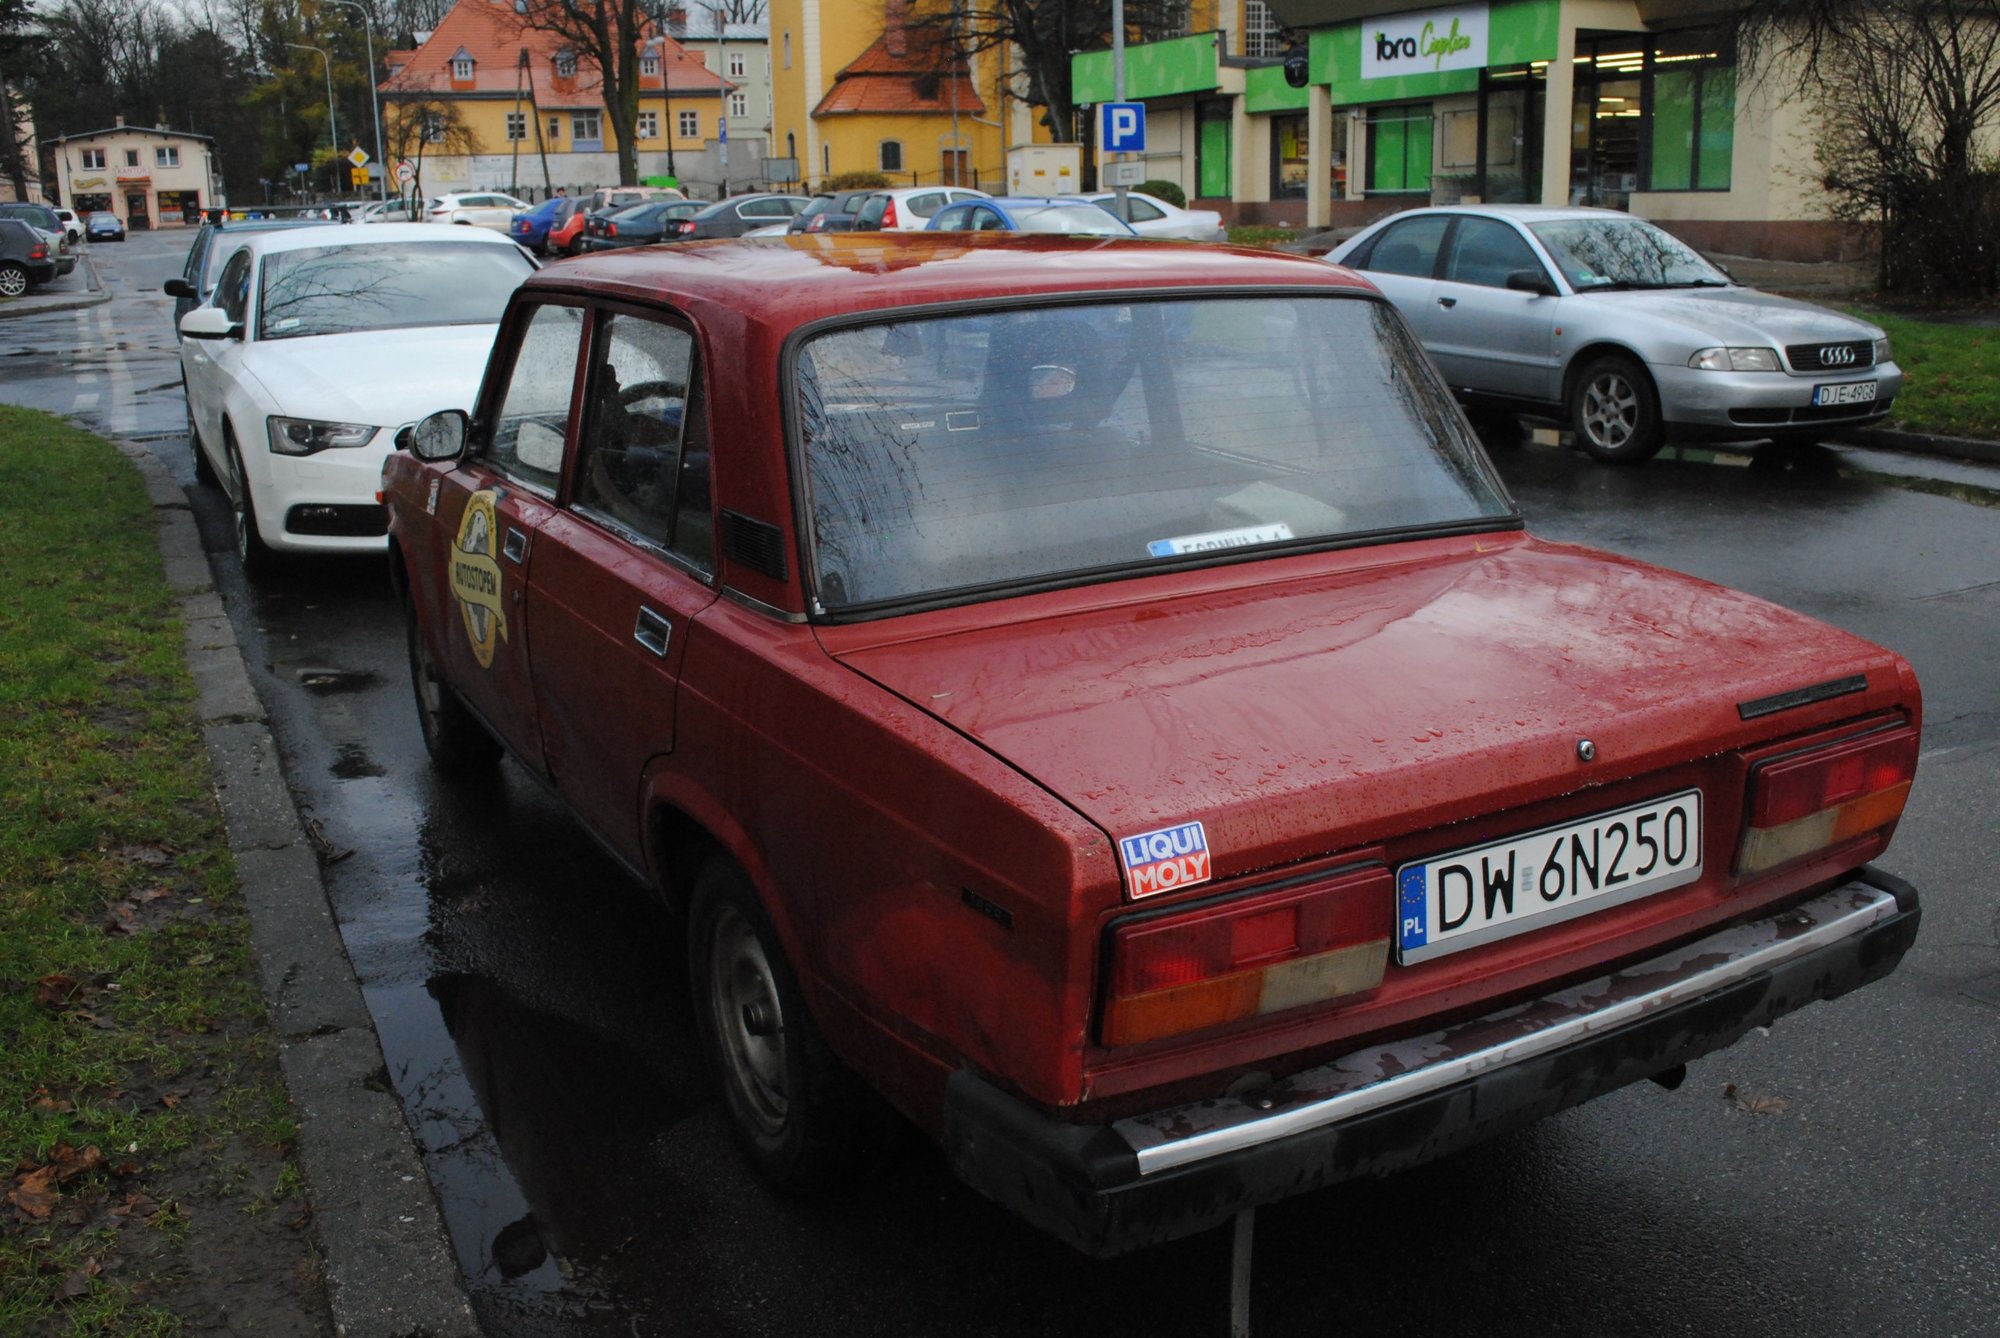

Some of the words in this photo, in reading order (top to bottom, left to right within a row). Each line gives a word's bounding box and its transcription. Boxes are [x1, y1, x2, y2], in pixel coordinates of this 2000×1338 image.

[1112, 108, 1137, 147] P
[1821, 386, 1847, 404] DJE
[1125, 825, 1202, 866] LIQUI
[1133, 853, 1207, 894] MOLY
[1438, 849, 1516, 932] DW
[1539, 805, 1688, 902] 6N250
[1404, 917, 1424, 937] PL
